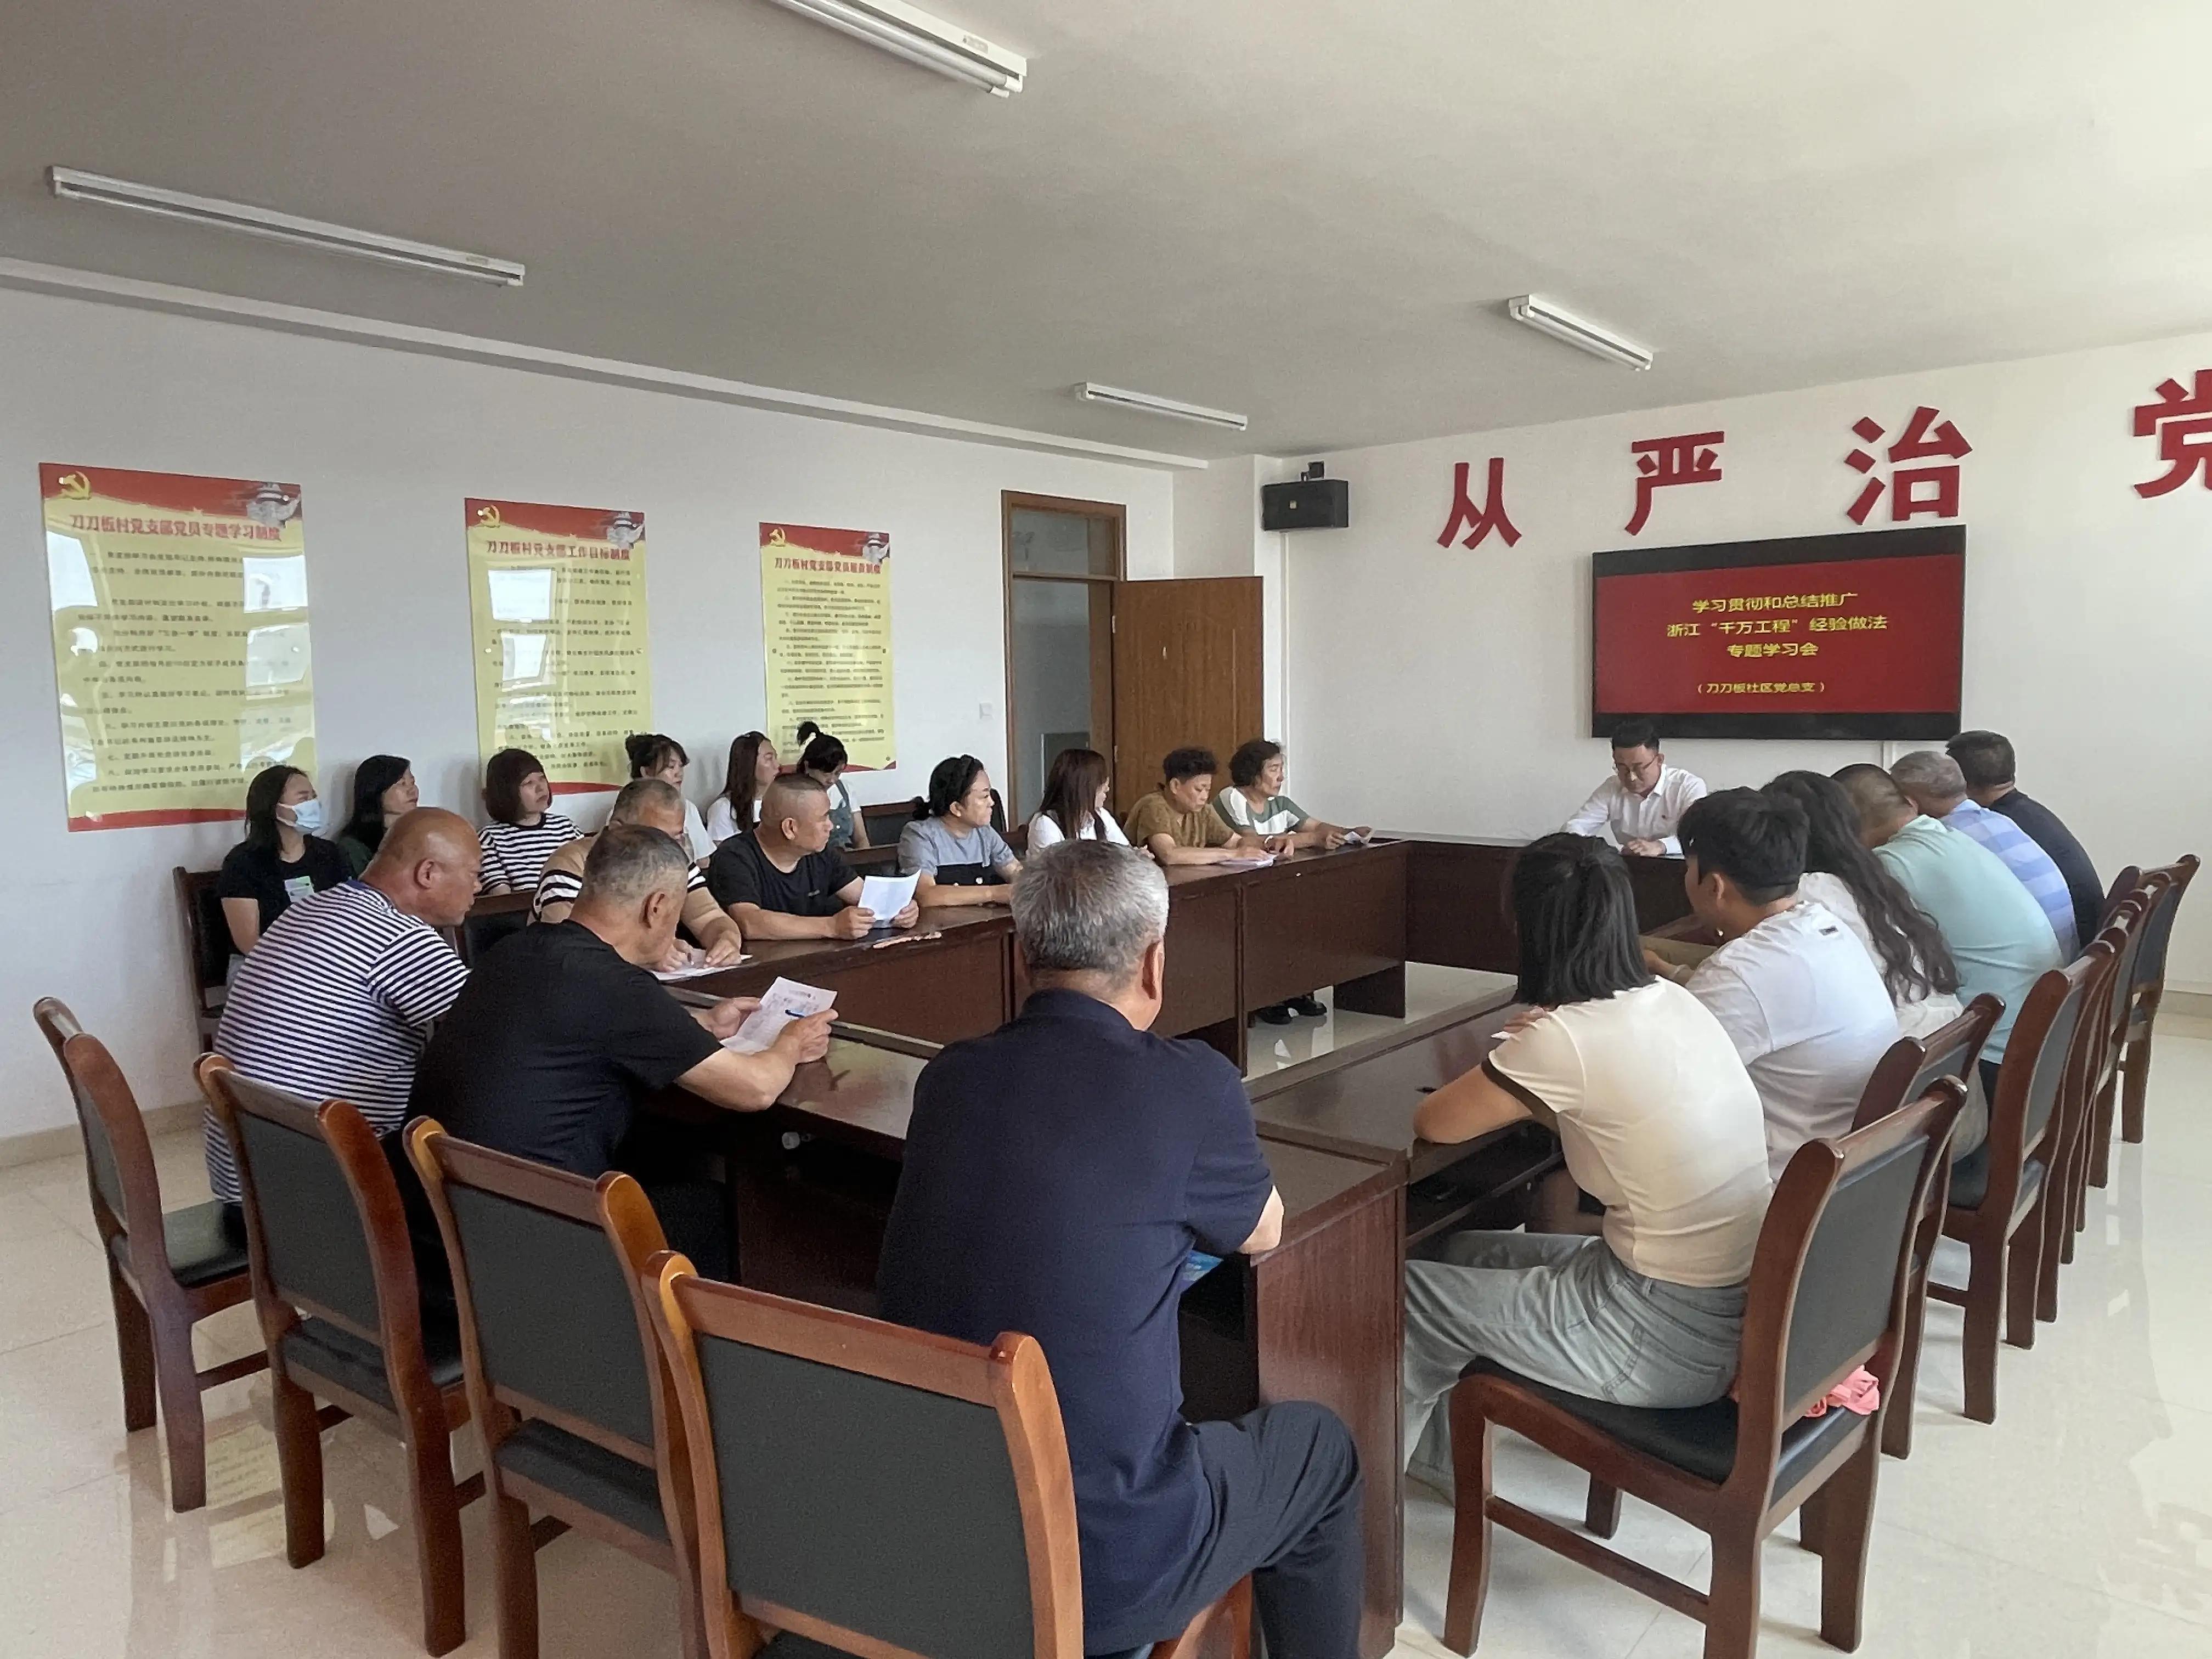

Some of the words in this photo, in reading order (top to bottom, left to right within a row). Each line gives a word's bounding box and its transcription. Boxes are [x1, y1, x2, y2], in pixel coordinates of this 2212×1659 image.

[1692, 592, 1858, 613] 学习贯彻和总结推广
[1727, 642, 1819, 658] 专题学习会
